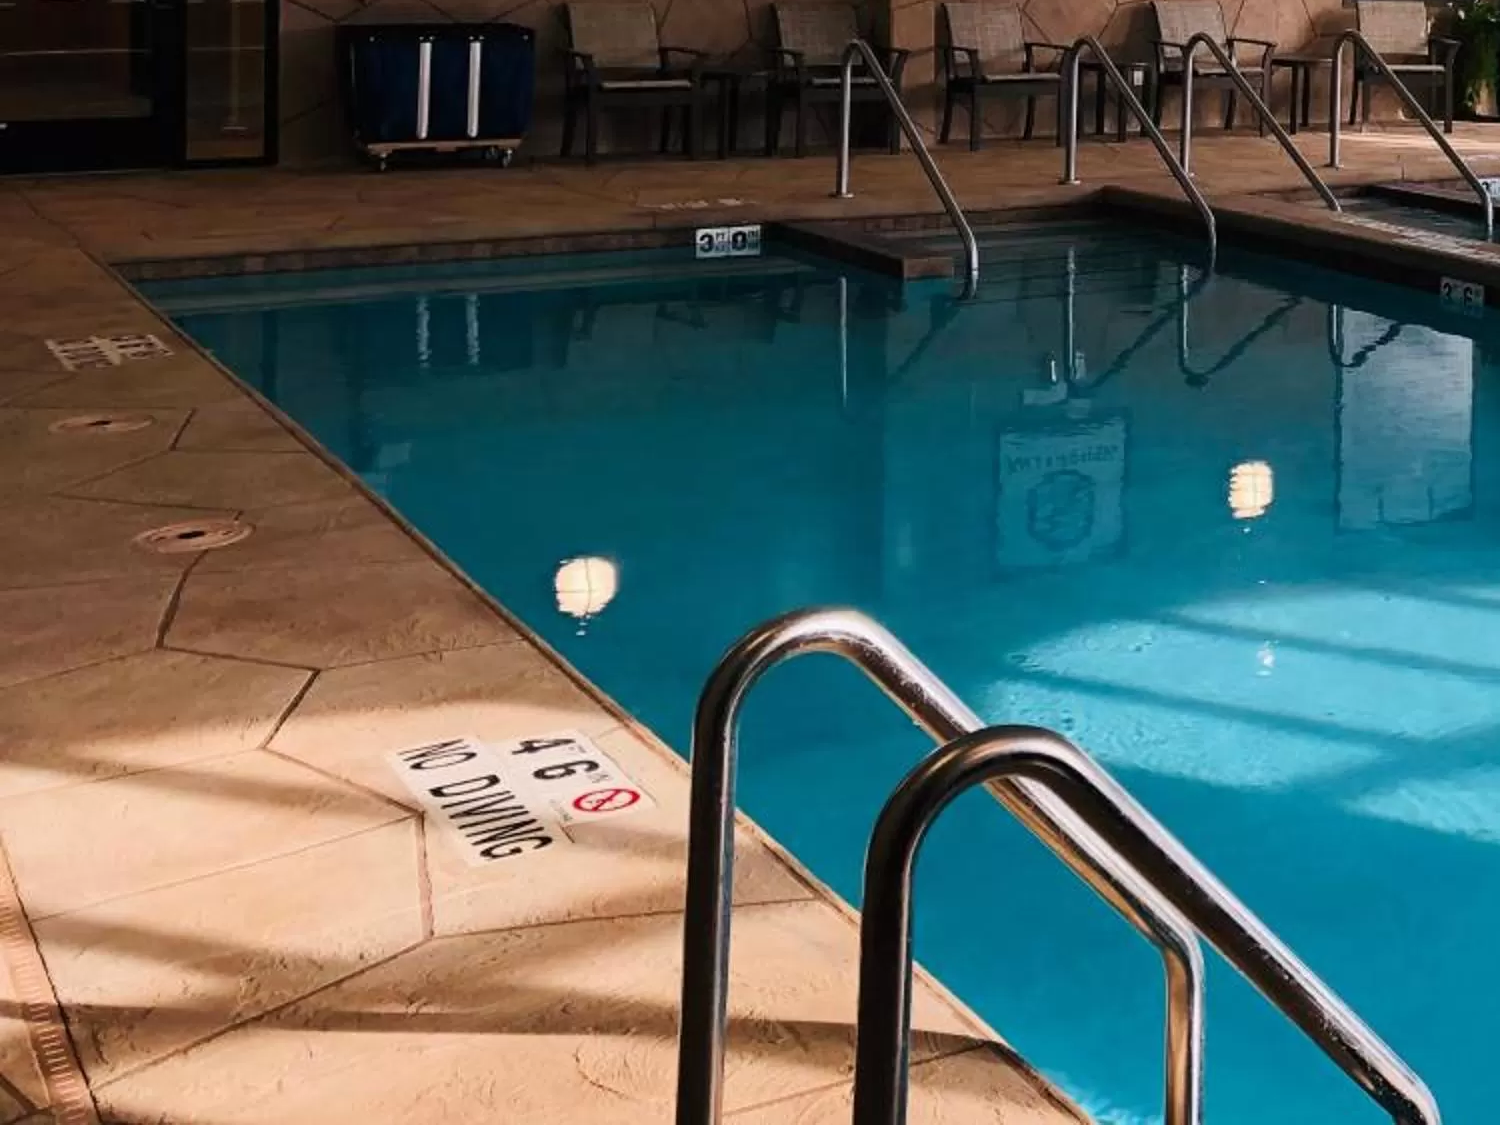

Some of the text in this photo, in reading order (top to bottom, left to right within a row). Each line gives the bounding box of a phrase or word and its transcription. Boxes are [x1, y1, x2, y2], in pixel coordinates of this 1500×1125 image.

[397, 738, 478, 770] NO
[511, 738, 576, 755] 4
[533, 759, 600, 781] 6
[429, 774, 554, 860] DIVING
